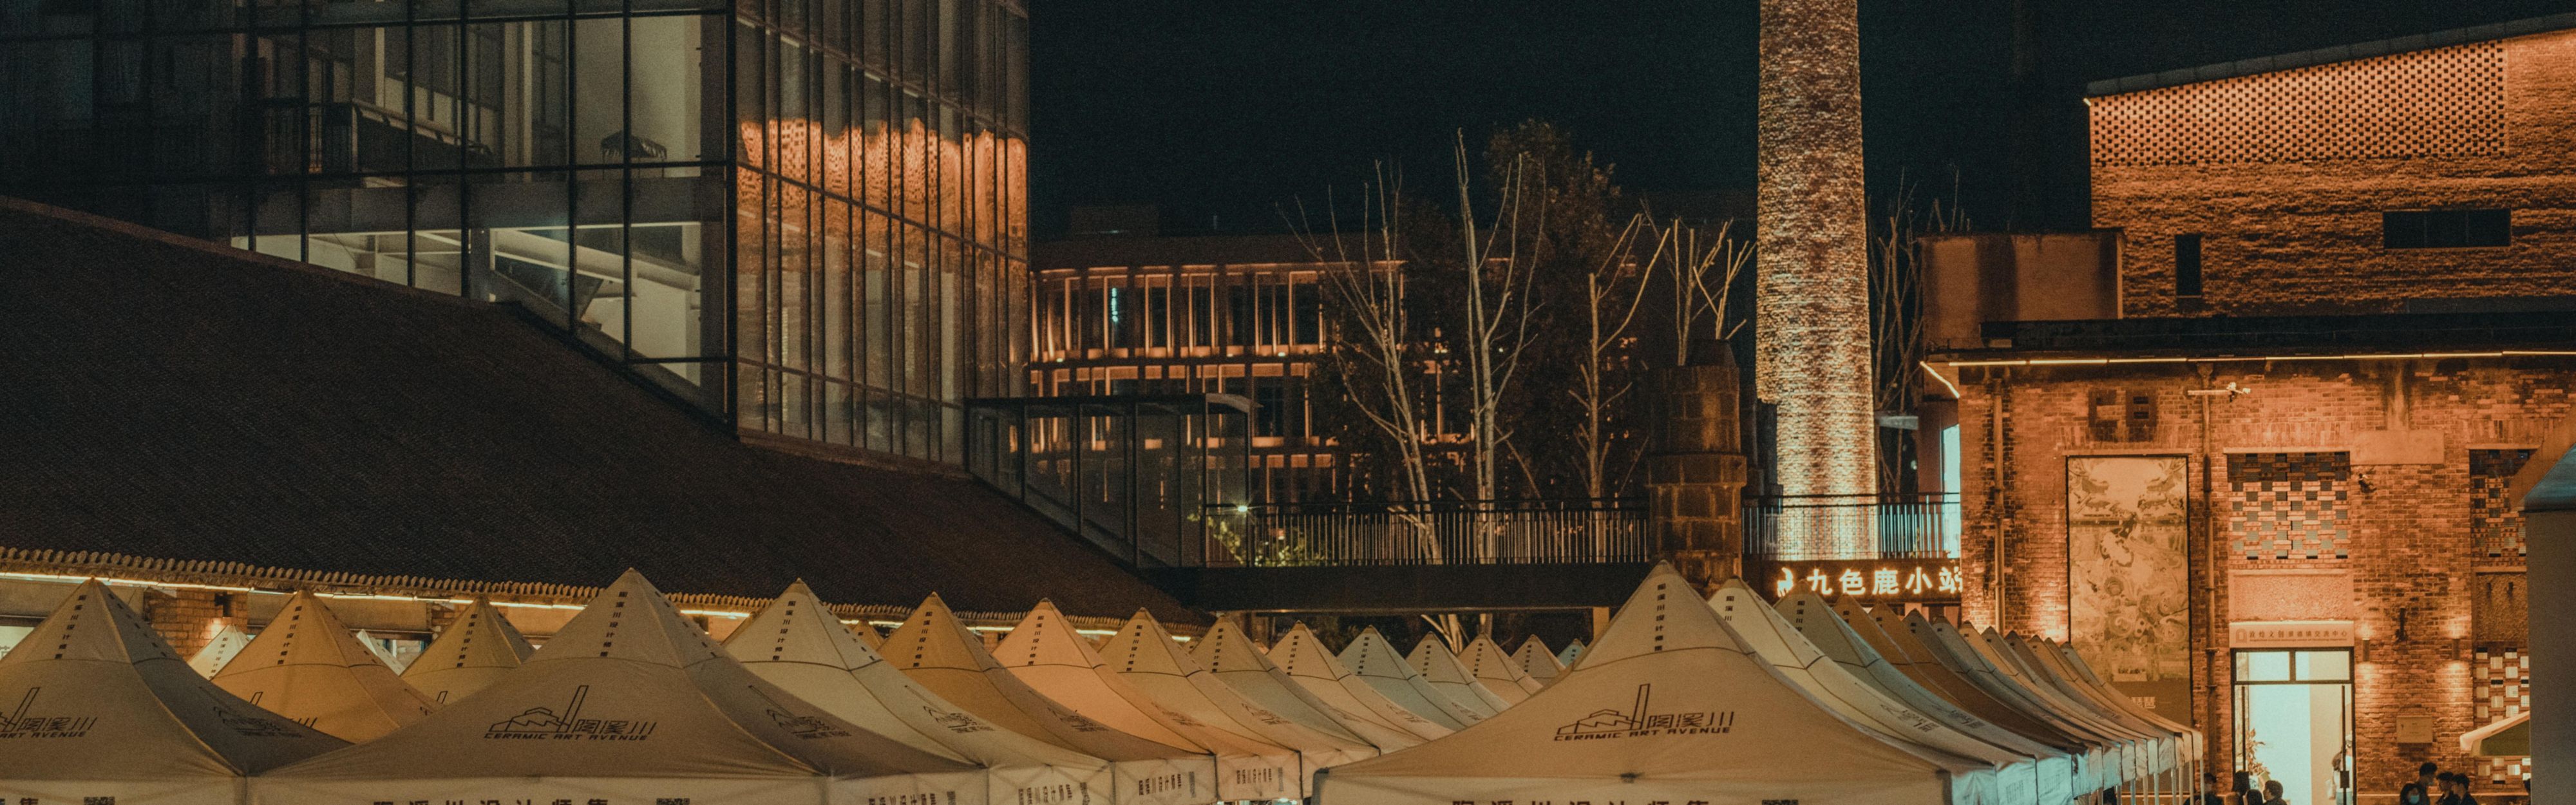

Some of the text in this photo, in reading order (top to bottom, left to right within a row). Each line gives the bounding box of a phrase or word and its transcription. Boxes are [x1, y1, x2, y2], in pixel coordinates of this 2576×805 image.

[1807, 567, 1962, 594] 九色鹿小站
[1554, 732, 1622, 741] CERAMIC
